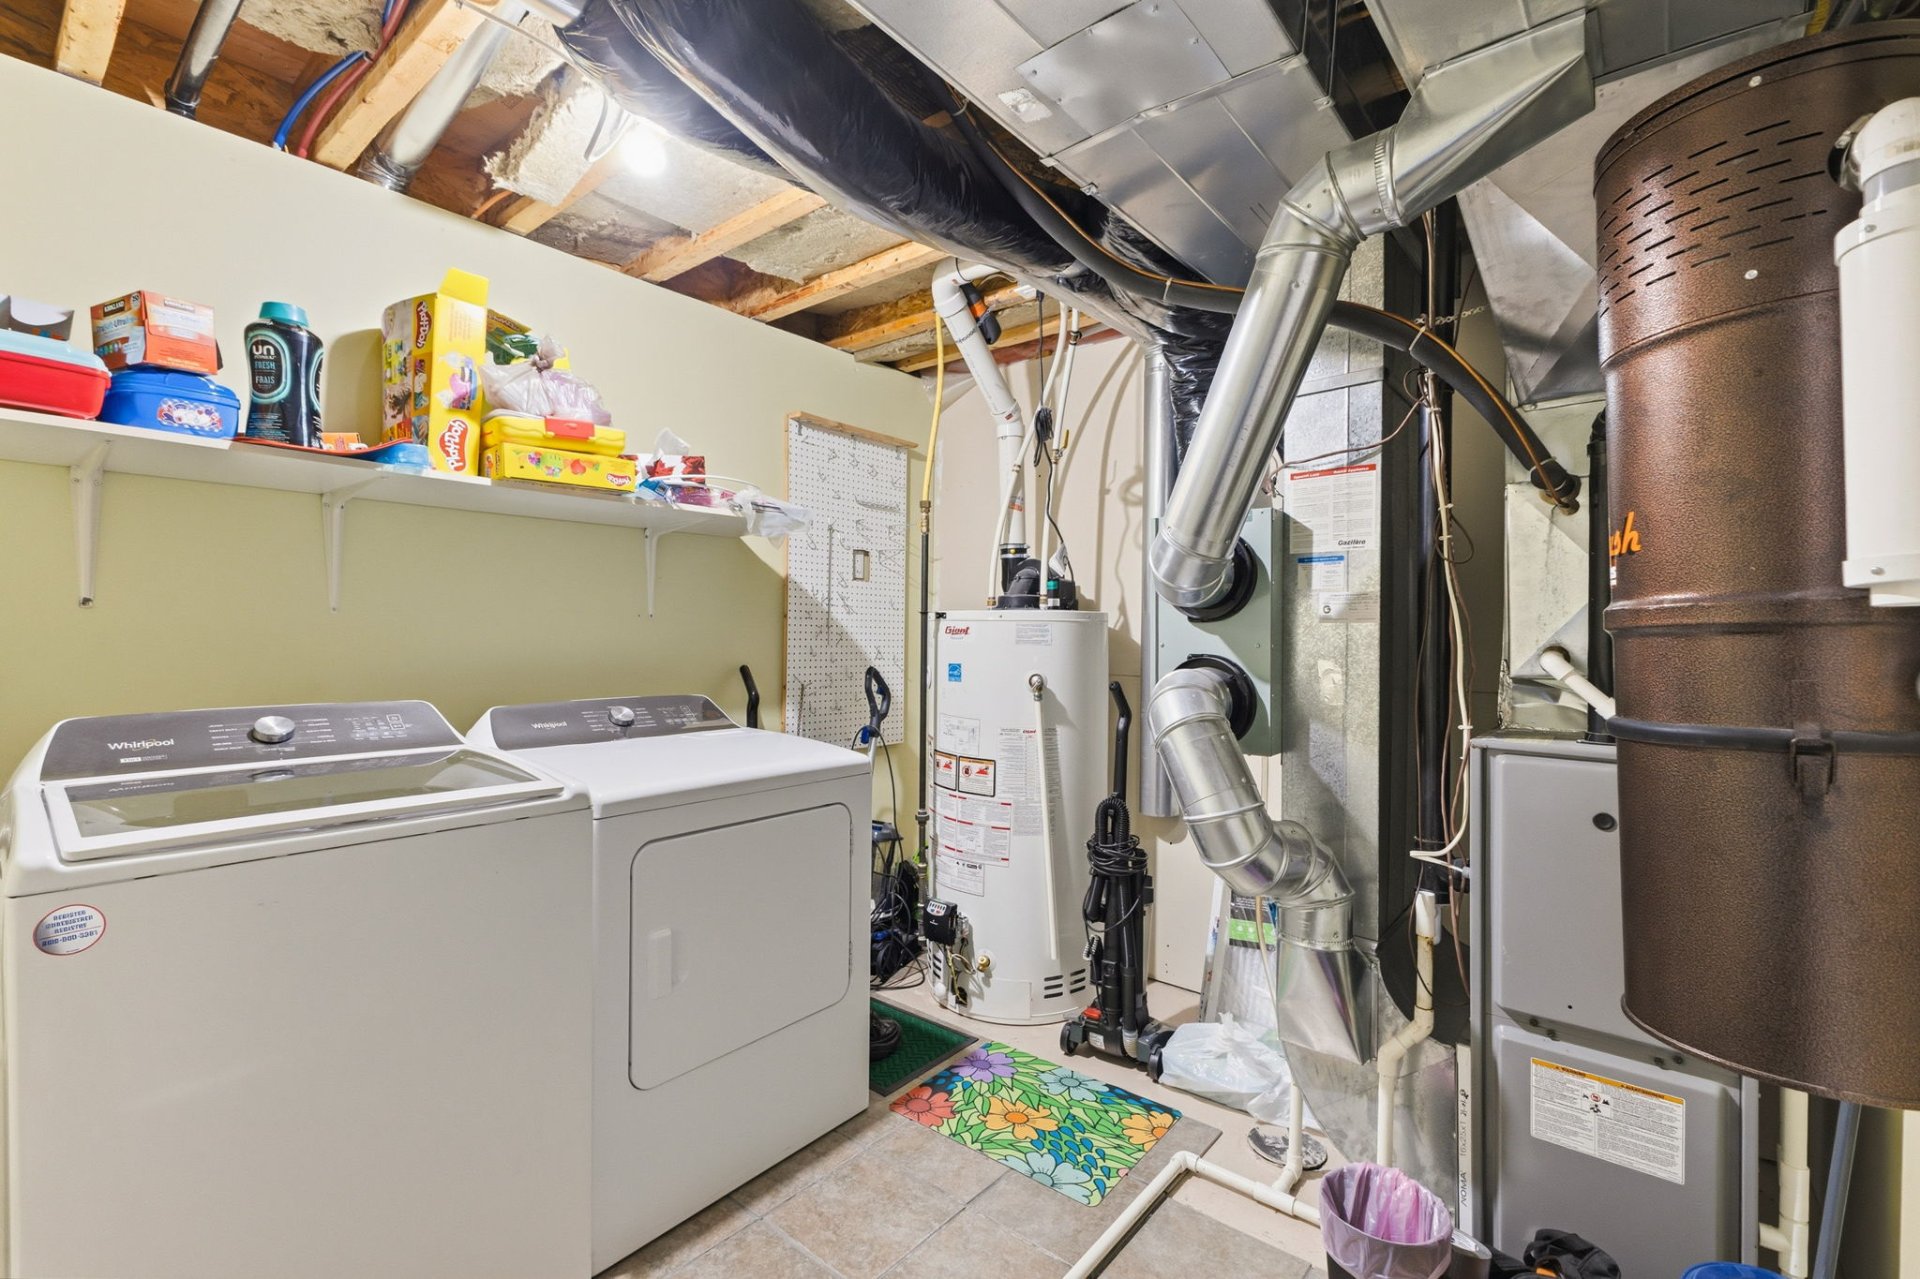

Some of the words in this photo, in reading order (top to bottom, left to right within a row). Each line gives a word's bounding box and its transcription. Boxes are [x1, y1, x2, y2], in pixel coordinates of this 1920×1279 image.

[254, 361, 276, 370] FRESH
[255, 375, 275, 384] FRAIS
[444, 419, 466, 470] Play-Doh
[107, 738, 175, 751] Whirlpool
